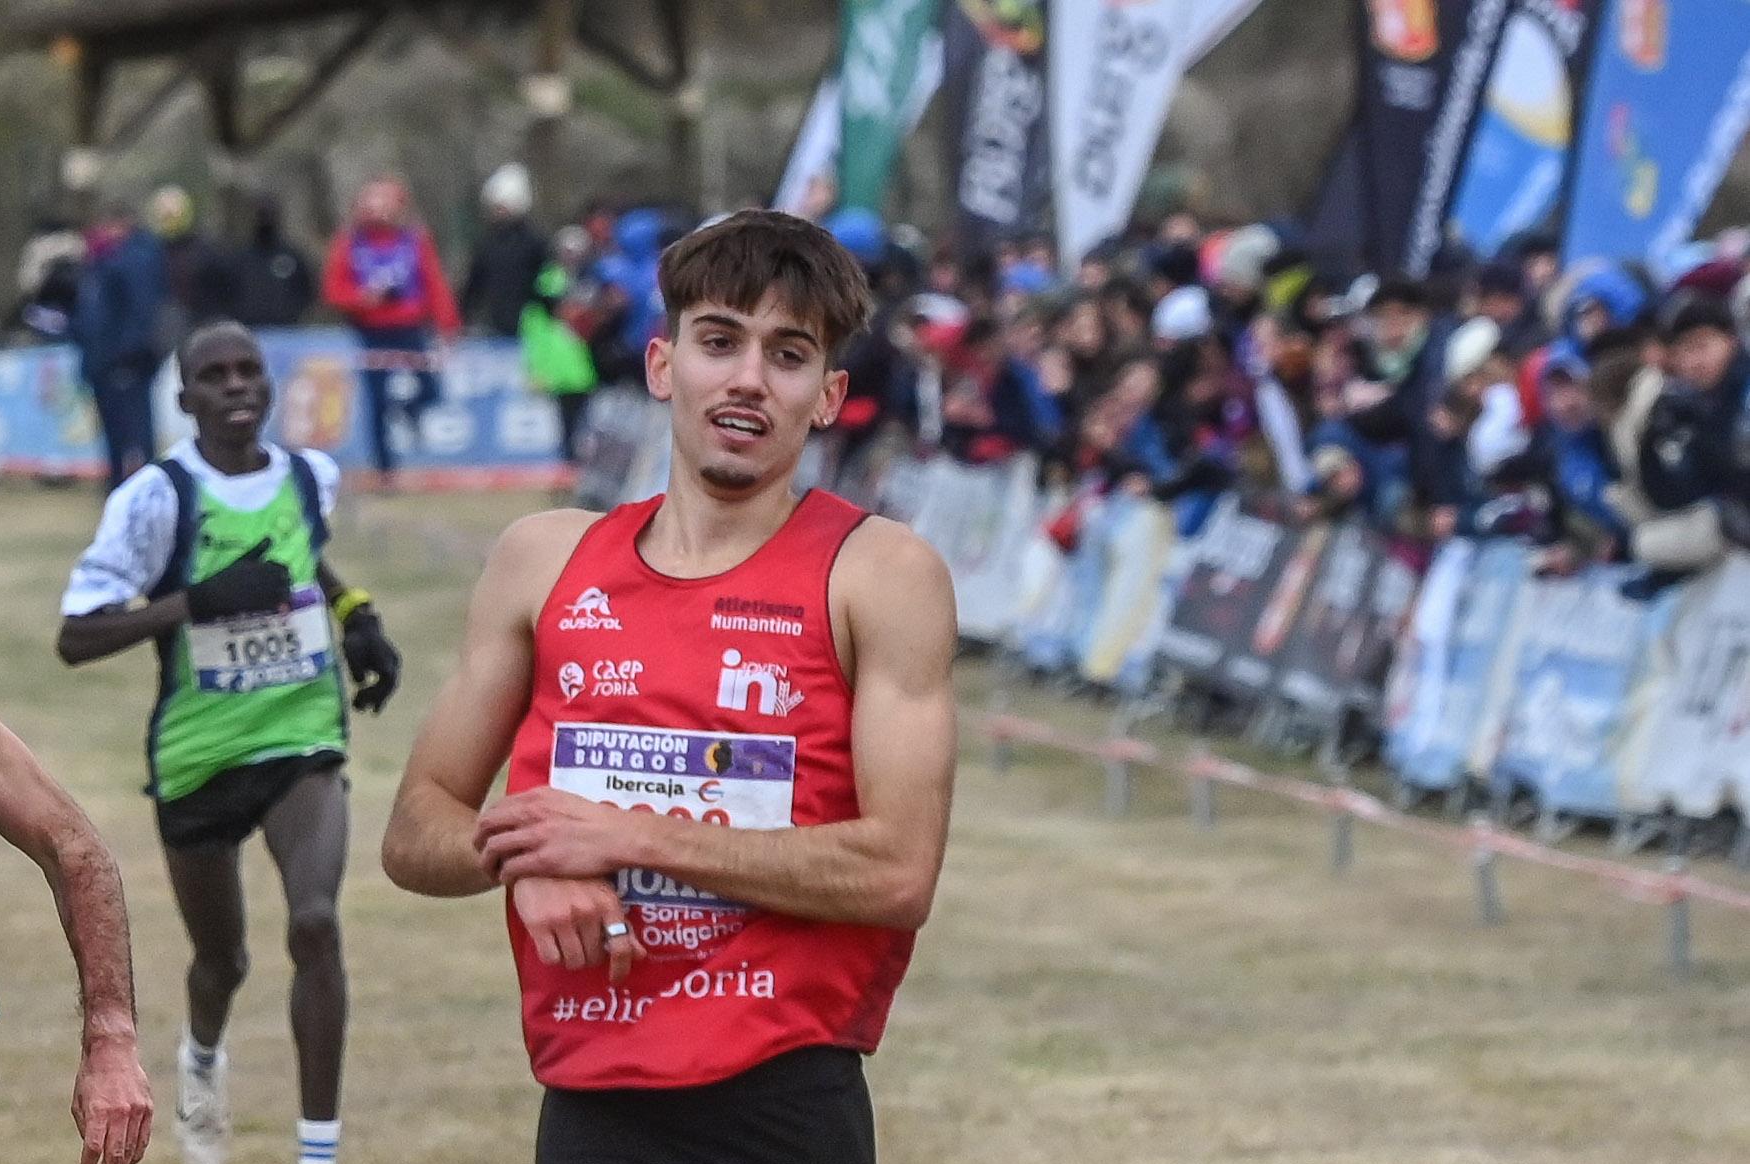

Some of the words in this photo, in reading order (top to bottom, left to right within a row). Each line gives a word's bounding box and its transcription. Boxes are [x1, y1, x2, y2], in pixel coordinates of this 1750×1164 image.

[711, 614, 803, 636] Numantino
[576, 731, 689, 755] DIPUTACIÓN
[574, 749, 688, 772] BURGOS
[606, 775, 685, 798] Ibercaja
